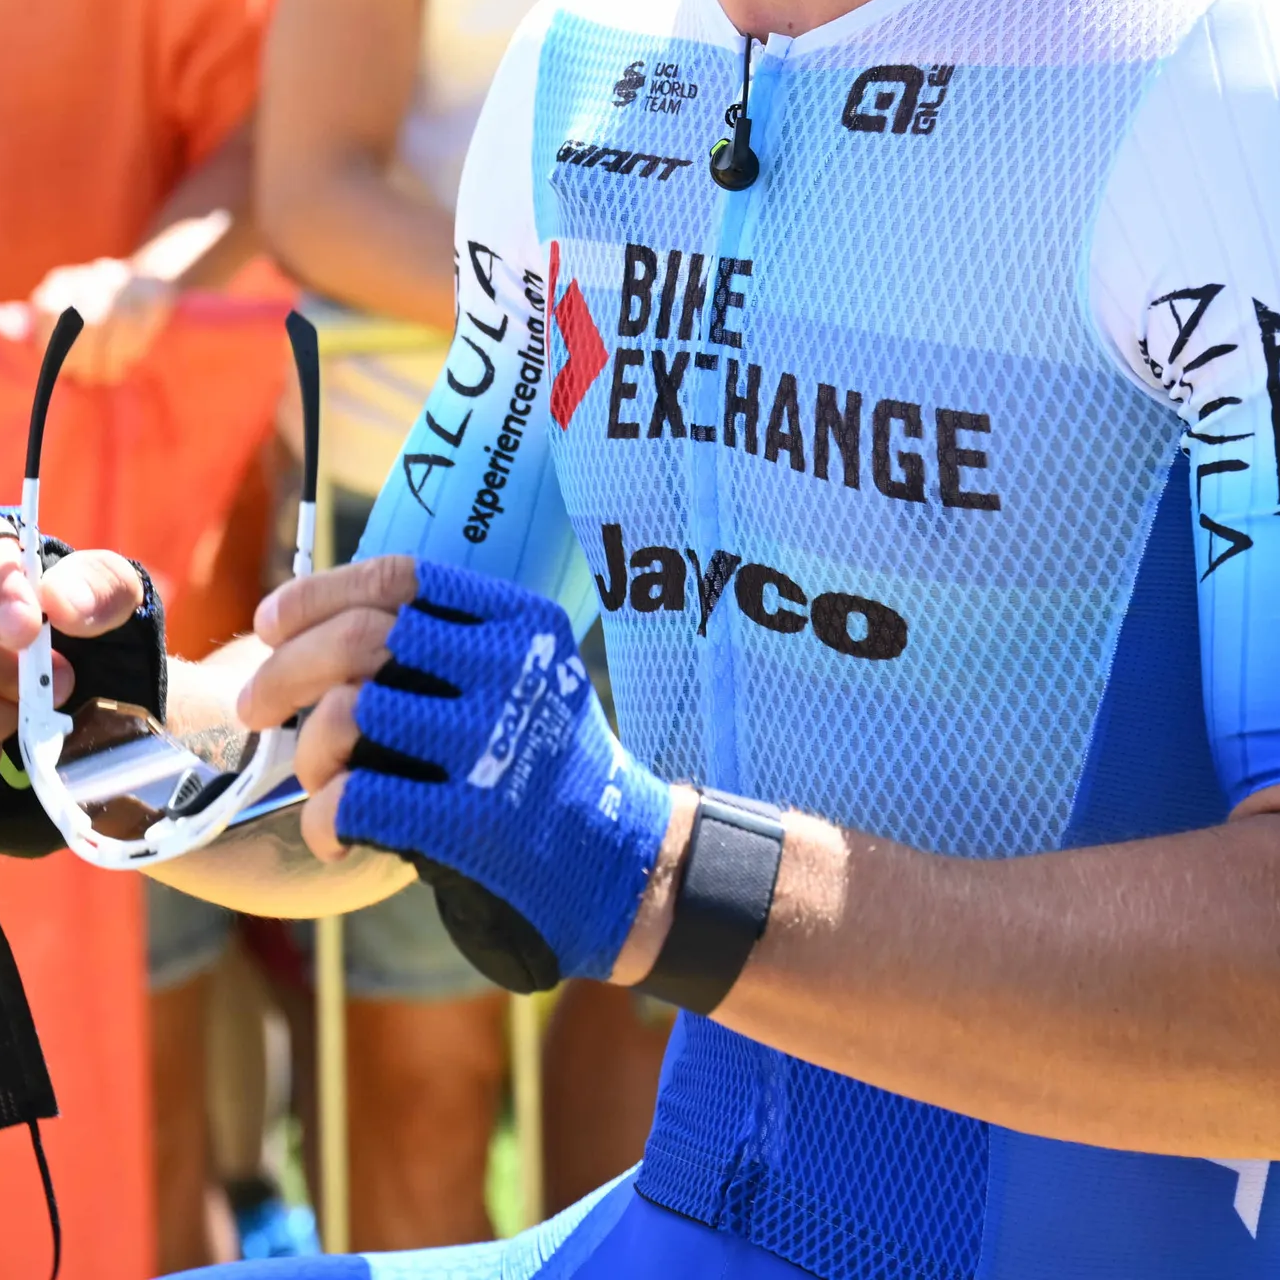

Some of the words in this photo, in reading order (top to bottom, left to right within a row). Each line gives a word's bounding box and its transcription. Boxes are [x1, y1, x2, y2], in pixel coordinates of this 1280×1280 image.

[650, 80, 698, 99] WORLD
[655, 63, 679, 78] UCI
[644, 96, 682, 115] TEAM
[556, 139, 693, 181] GIANT
[617, 242, 754, 350] BIKE
[404, 240, 508, 518] ALULA
[594, 523, 908, 660] Jayco
